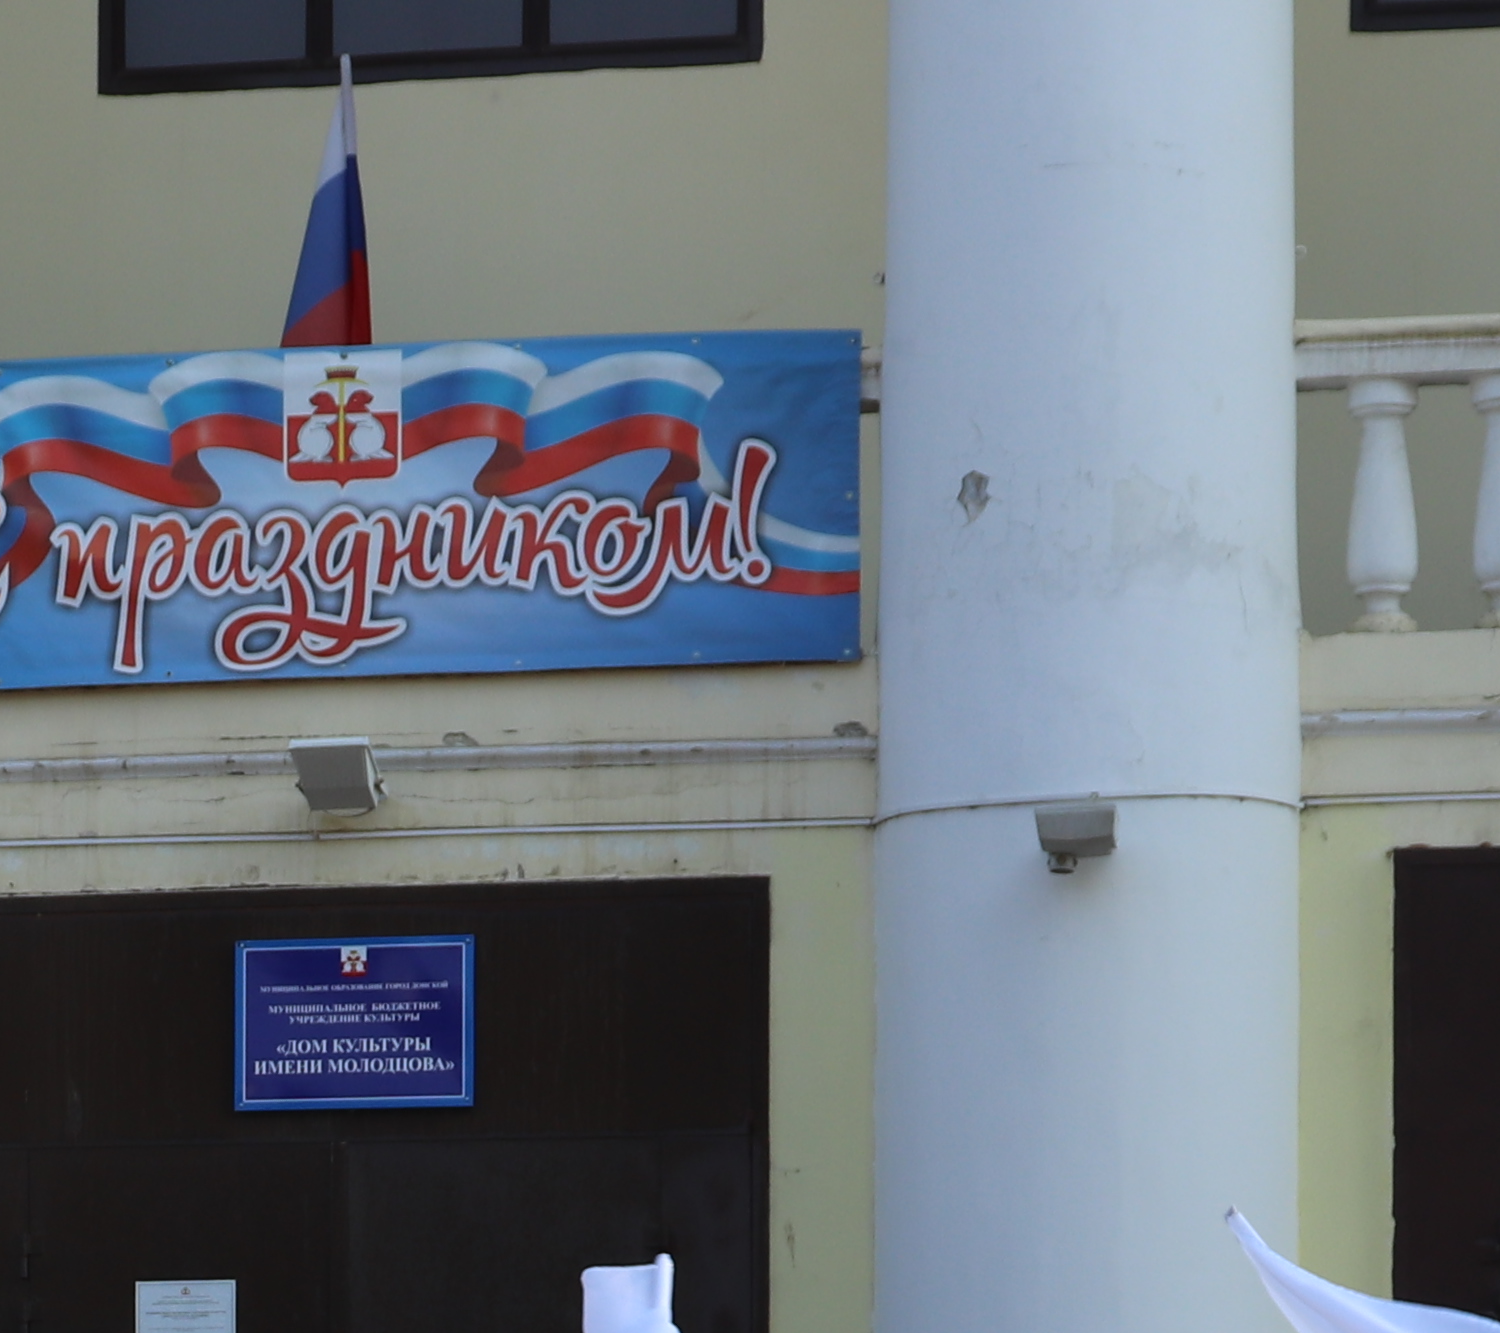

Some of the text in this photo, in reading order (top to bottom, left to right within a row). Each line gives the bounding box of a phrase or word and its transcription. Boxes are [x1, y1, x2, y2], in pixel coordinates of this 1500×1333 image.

[49, 437, 777, 673] праздником!
[268, 1001, 441, 1014] МУНИЦИПАЛЬНОЕ БЮДЖЕТНОЕ
[289, 1012, 421, 1024] УЧРЕЖДЕНИЕ КУЛЬТУРЫ
[276, 1036, 431, 1056] «ДОМ КУЛЬТУРЫ
[254, 1056, 455, 1075] ИМЕНИ МОЛОДЦОВА»
